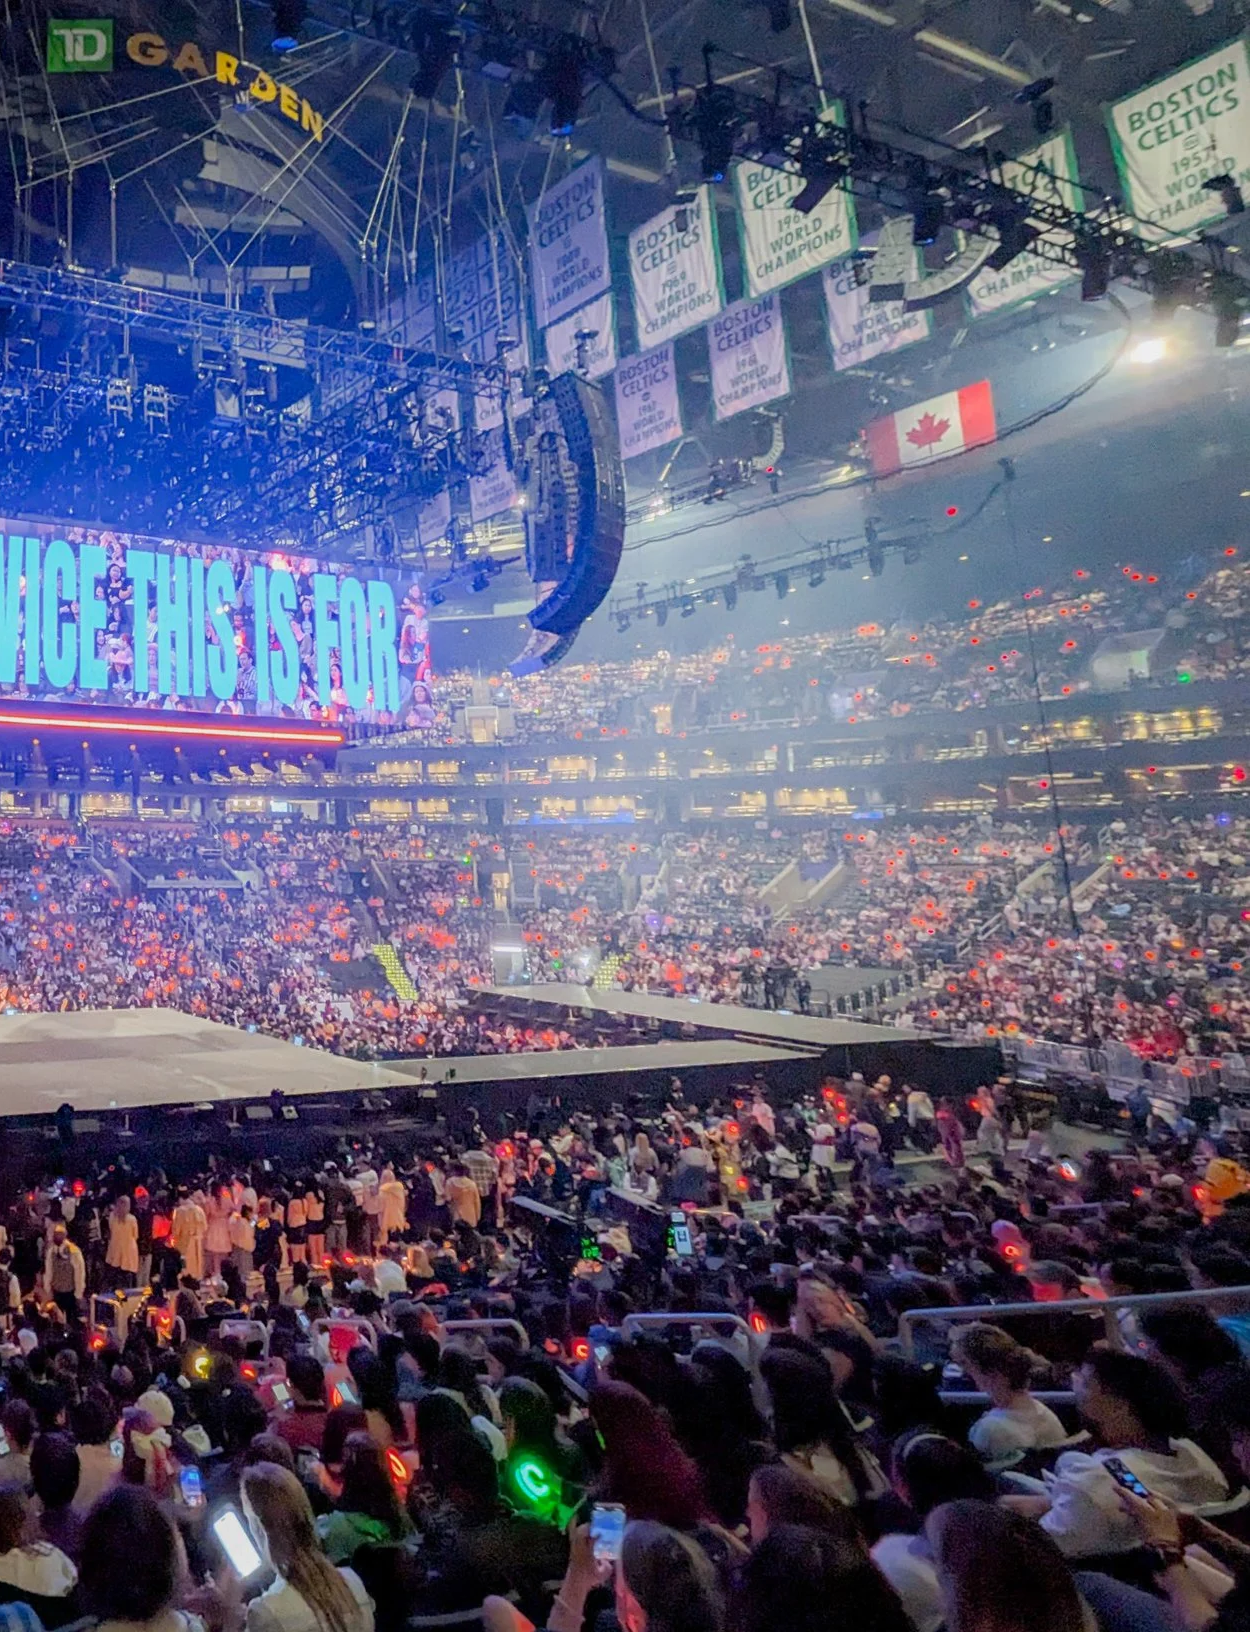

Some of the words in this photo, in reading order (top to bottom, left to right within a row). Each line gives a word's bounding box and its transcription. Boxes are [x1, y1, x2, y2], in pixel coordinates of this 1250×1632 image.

[53, 29, 107, 62] TD
[126, 32, 323, 143] GARDEN
[1128, 62, 1237, 133] BOSTON
[1137, 89, 1239, 151] CELTICS
[636, 201, 701, 257] BOSTN
[770, 217, 822, 253] WORLD
[778, 212, 808, 233] 196
[640, 224, 701, 273] CELTICS
[756, 223, 842, 279] CHAMPIONS
[644, 288, 713, 335] CHAMPIONS
[654, 281, 697, 314] WORLD
[713, 294, 774, 338] BOSTON
[718, 315, 772, 352] CELTICS
[619, 348, 669, 385] BOSTON
[622, 365, 669, 398] CELTICS
[126, 549, 240, 701] THIS
[253, 565, 301, 705] IS
[313, 573, 401, 714] FOR
